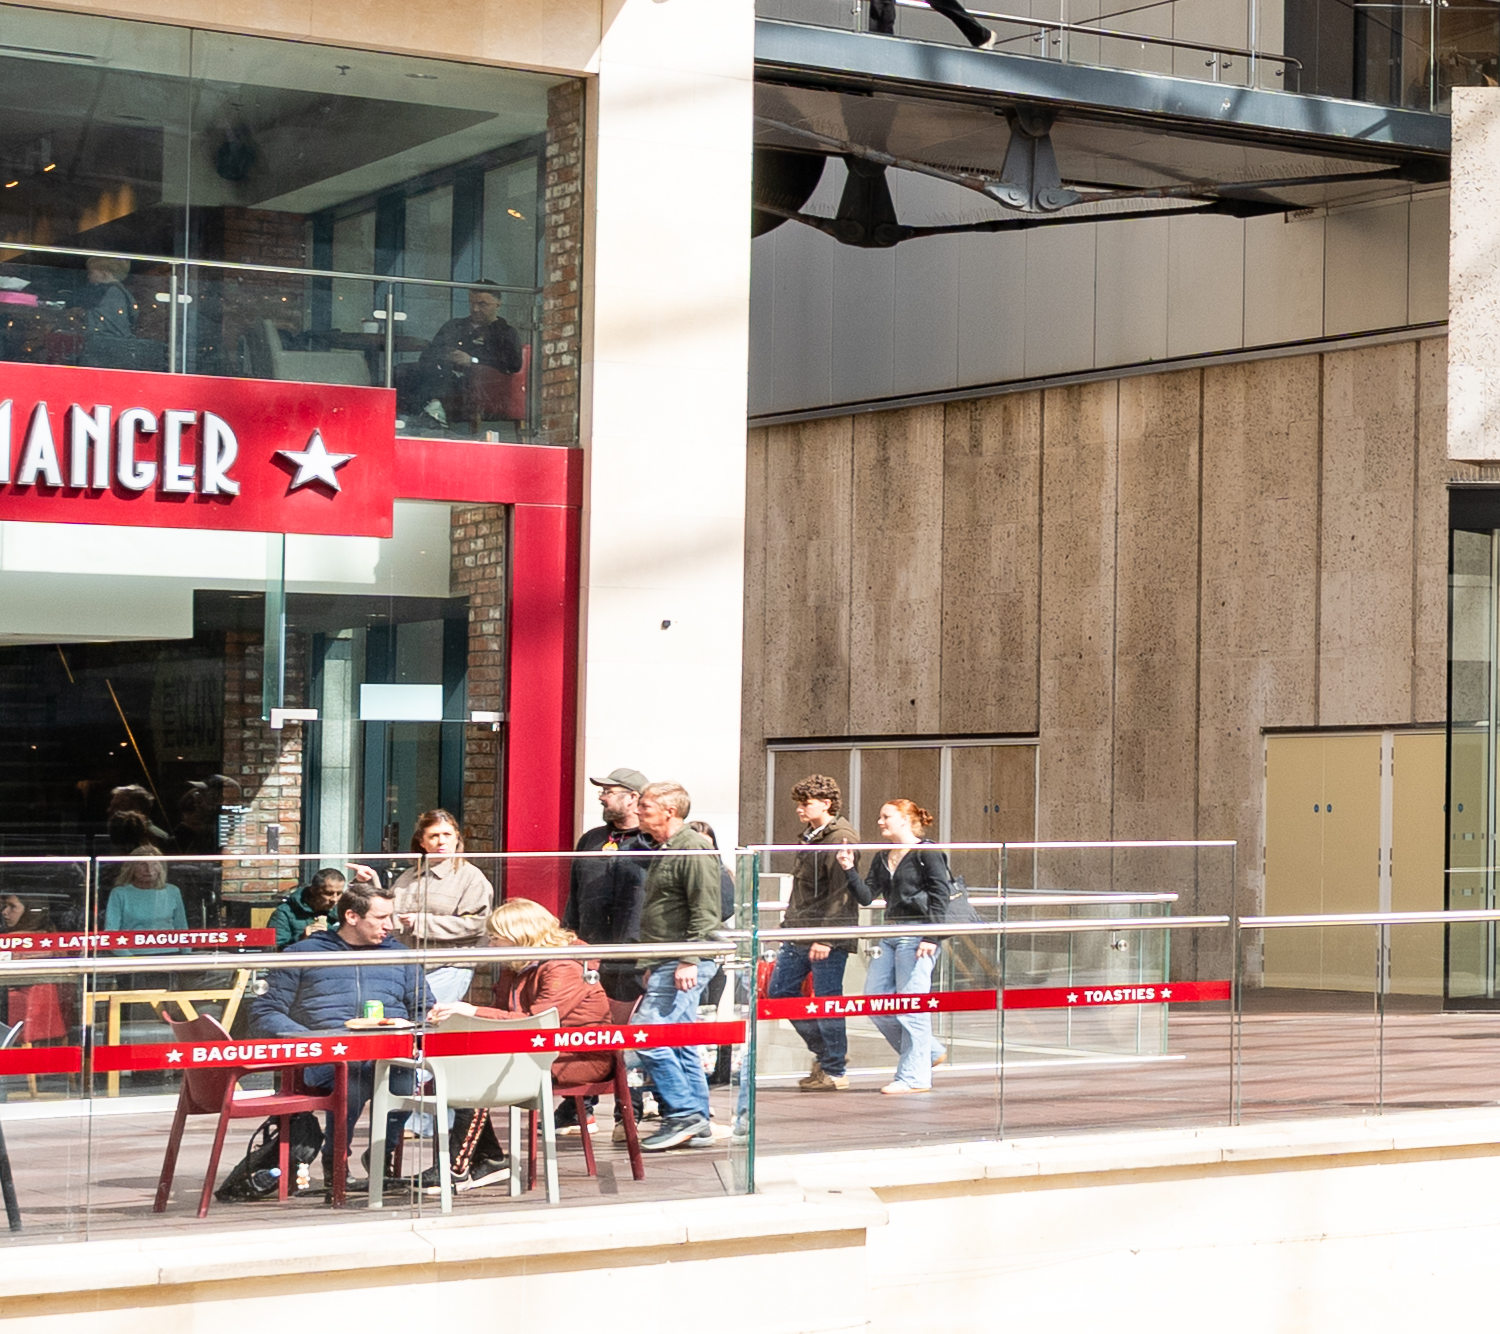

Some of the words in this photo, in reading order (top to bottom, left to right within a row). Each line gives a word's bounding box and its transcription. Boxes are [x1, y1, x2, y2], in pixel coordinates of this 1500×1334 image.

[58, 934, 110, 948] LATTE
[135, 932, 229, 945] BAGUETTES
[1084, 988, 1155, 1002] TOASTIES
[825, 999, 865, 1013] FLAT
[870, 997, 921, 1011] WHITE
[554, 1031, 625, 1047] MOCHA
[192, 1043, 322, 1062] BAGUETTES
